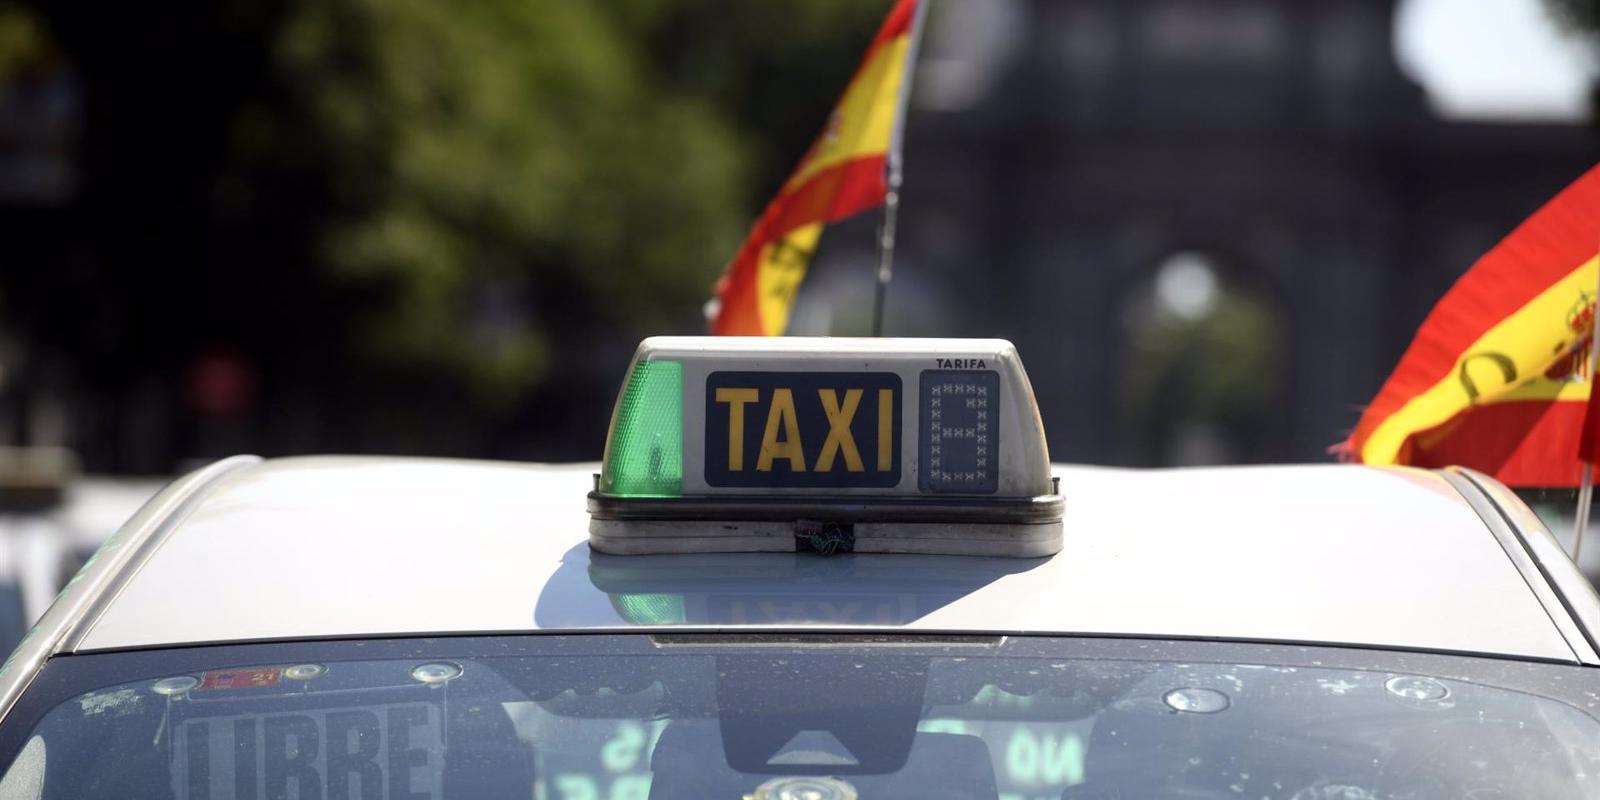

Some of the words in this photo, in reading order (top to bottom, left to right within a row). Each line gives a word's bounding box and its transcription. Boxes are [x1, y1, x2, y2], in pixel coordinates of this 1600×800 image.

[936, 358, 986, 369] TARIFA
[715, 388, 893, 472] TAXI
[186, 704, 435, 800] LIBRE
